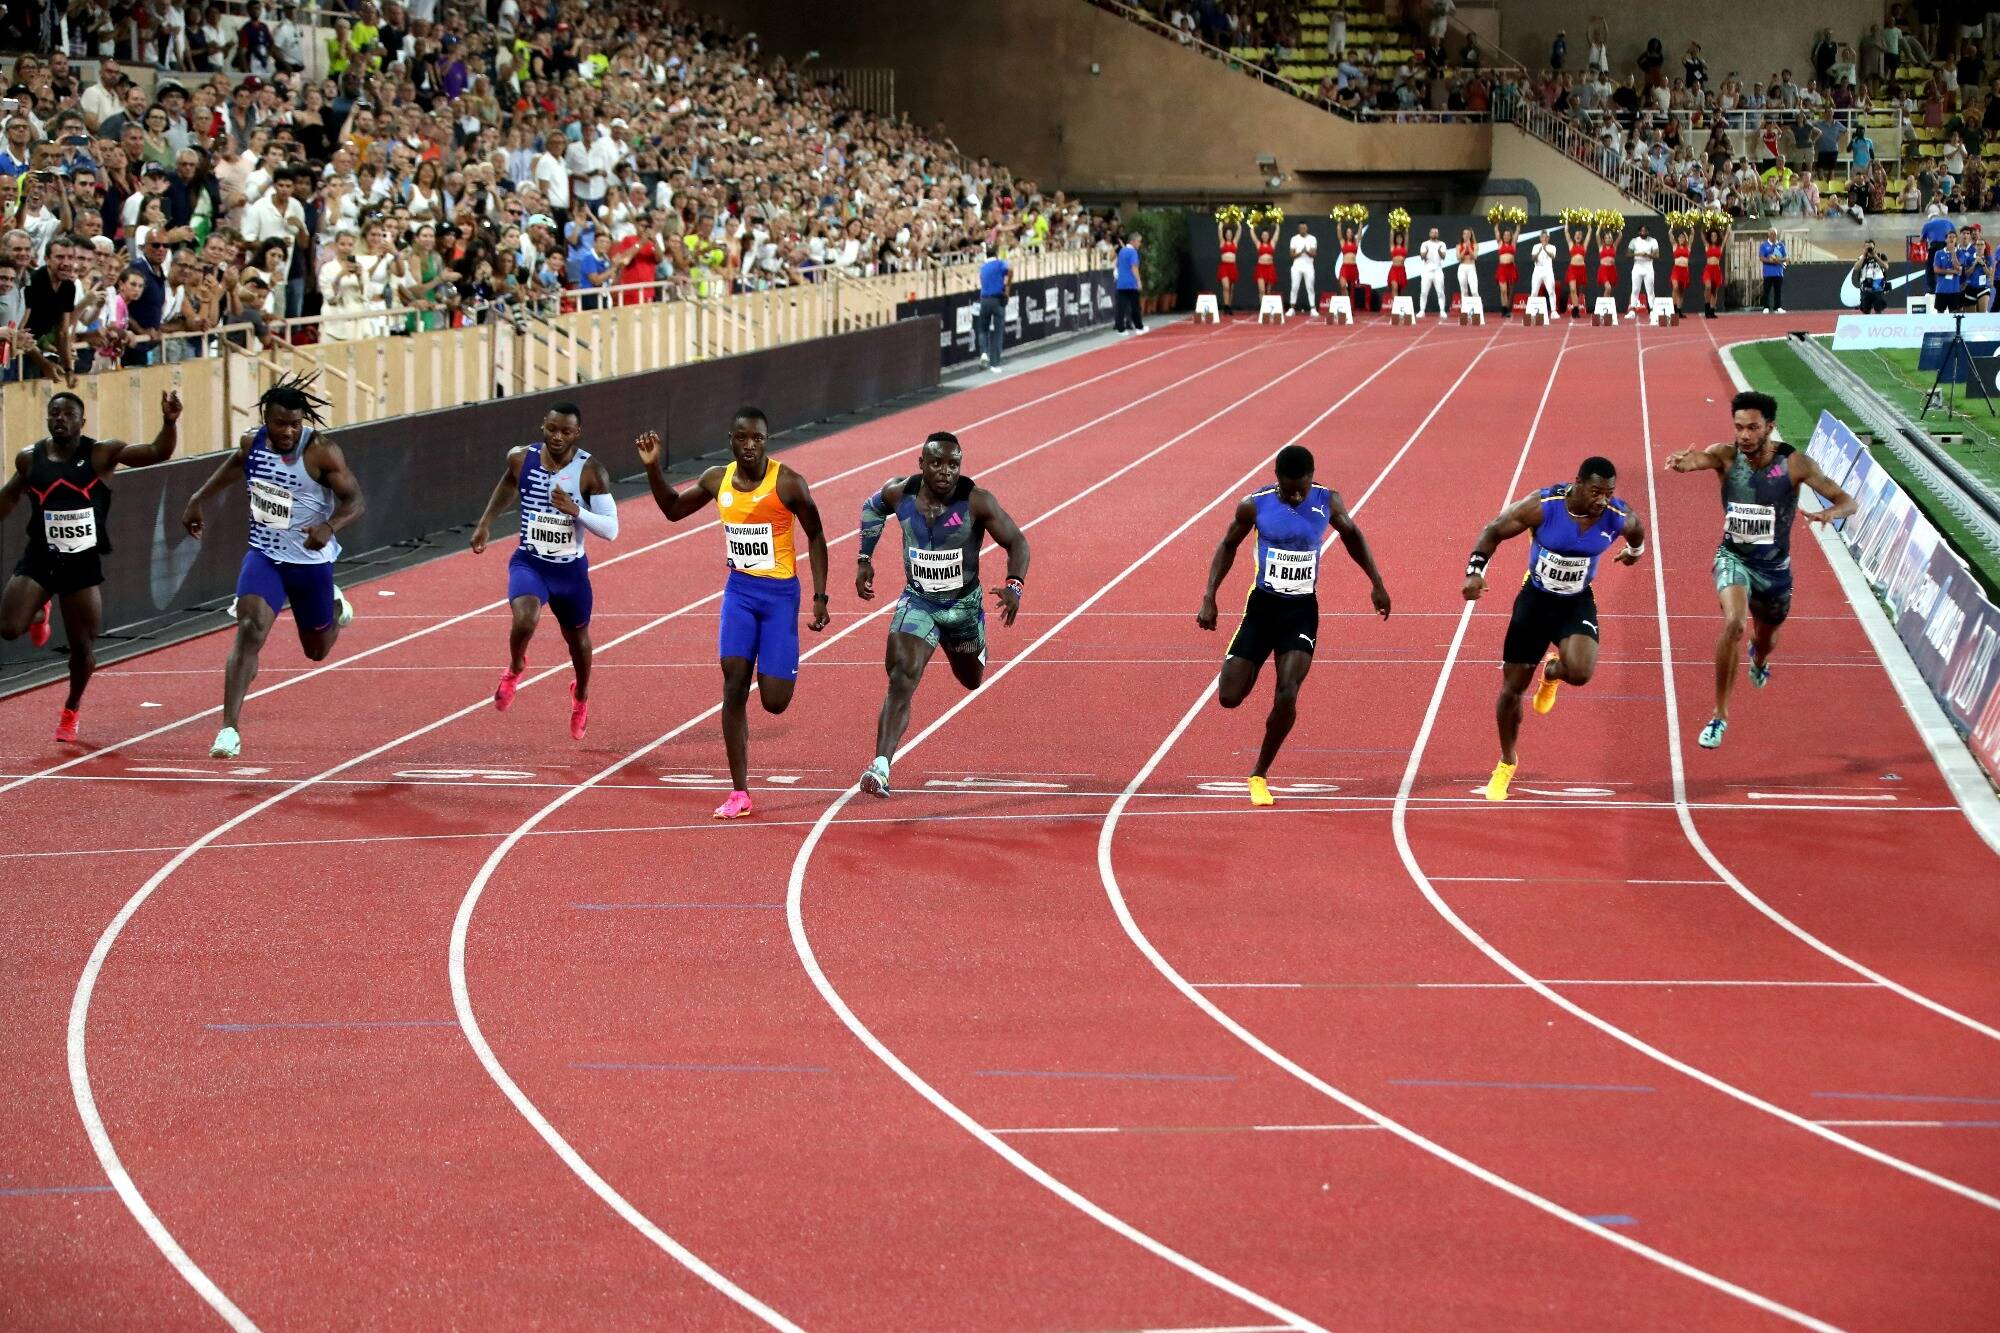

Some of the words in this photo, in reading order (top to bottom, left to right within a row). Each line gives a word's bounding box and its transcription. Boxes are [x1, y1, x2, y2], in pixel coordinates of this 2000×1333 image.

[1868, 325, 1923, 338] WORLD
[49, 523, 93, 539] CISSE
[1728, 516, 1771, 536] HARTMANN
[531, 527, 573, 544] LINDSEY
[729, 539, 769, 556] TEBOGO
[918, 551, 959, 561] SLOVENIJALES
[1276, 552, 1313, 562] SLOVENIJALES
[913, 563, 961, 580] OMANYALA
[1269, 563, 1279, 579] A.
[1280, 566, 1313, 580] BLAKE
[1539, 561, 1547, 576] Y.
[1549, 568, 1584, 582] BLAKE
